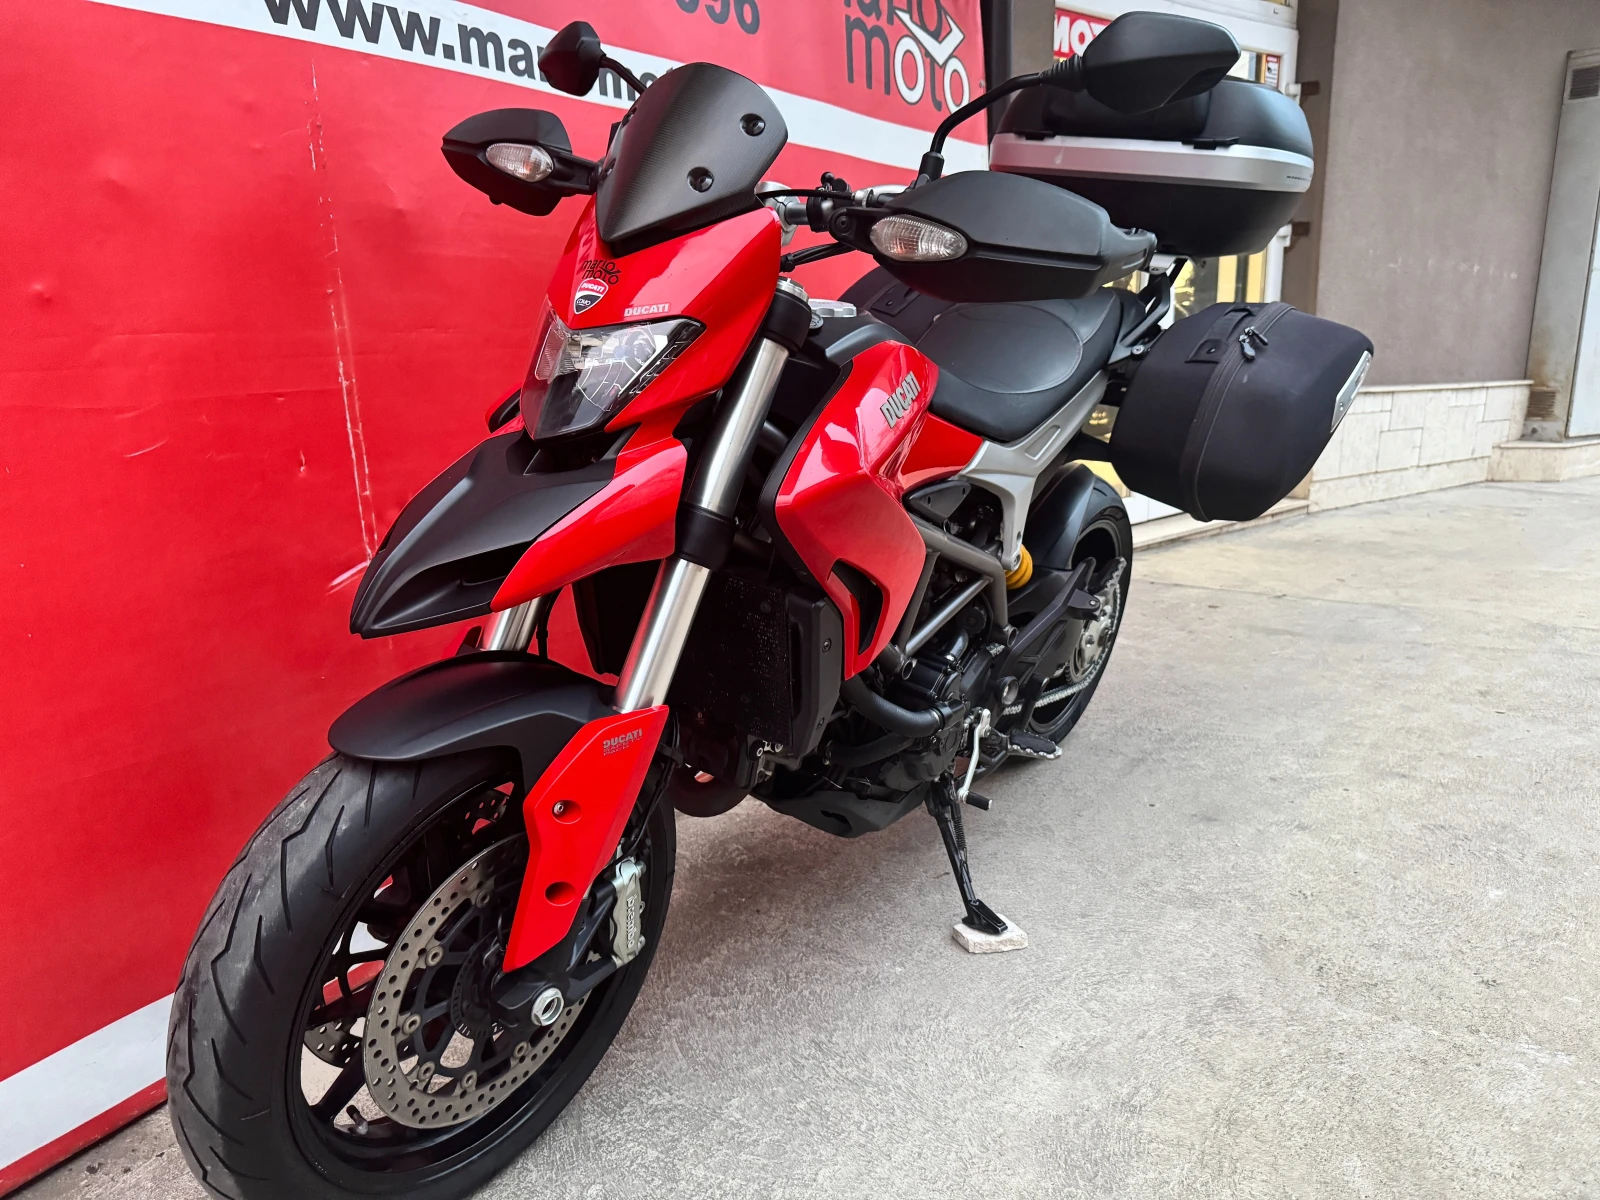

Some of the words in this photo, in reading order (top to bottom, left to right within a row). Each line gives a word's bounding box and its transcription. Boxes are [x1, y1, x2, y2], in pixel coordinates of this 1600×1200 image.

[580, 282, 605, 293] DUCATI
[624, 303, 669, 317] DUCATI
[880, 371, 921, 429] DUCATI
[603, 728, 643, 749] DUCATI
[626, 893, 638, 949] brembo
